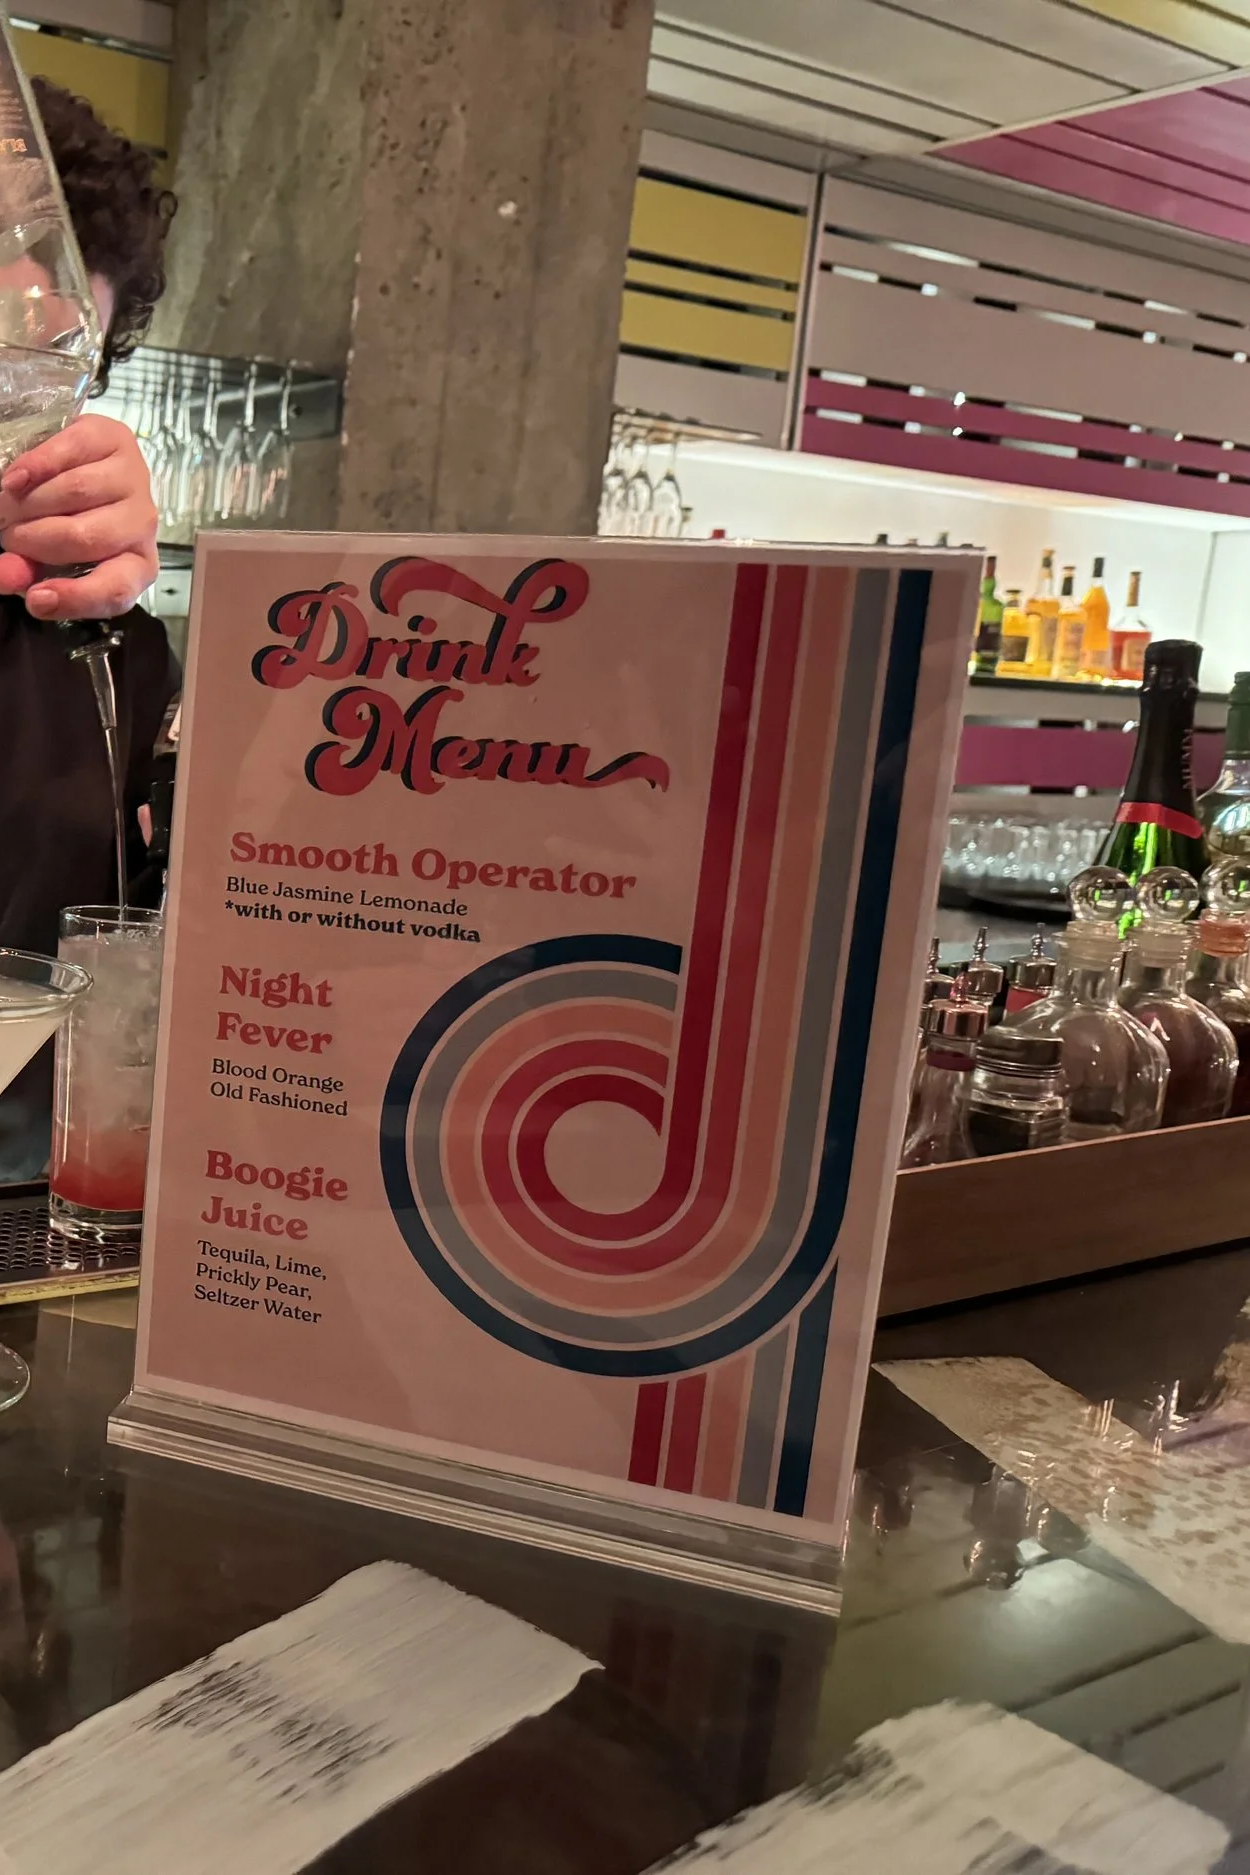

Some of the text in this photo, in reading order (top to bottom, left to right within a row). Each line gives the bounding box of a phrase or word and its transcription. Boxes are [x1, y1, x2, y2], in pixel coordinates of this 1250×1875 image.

[251, 556, 590, 689] Drink
[304, 685, 670, 797] Menu
[230, 831, 636, 899] Smooth Operator
[226, 876, 468, 917] Blue Jasmine Lemonade
[287, 911, 313, 925] or
[317, 911, 405, 935] without
[410, 922, 481, 943] vodka
[219, 965, 333, 1009] Night
[215, 1011, 333, 1055] Fever
[212, 1058, 344, 1094] Blood Orange
[210, 1081, 349, 1117] Old Fashioned
[205, 1149, 349, 1202] Boogie
[201, 1196, 309, 1241] Juice
[197, 1240, 327, 1281] Tequila, Lime,
[196, 1262, 313, 1302] Prickly Pear,
[194, 1284, 322, 1325] Seltzer Water
